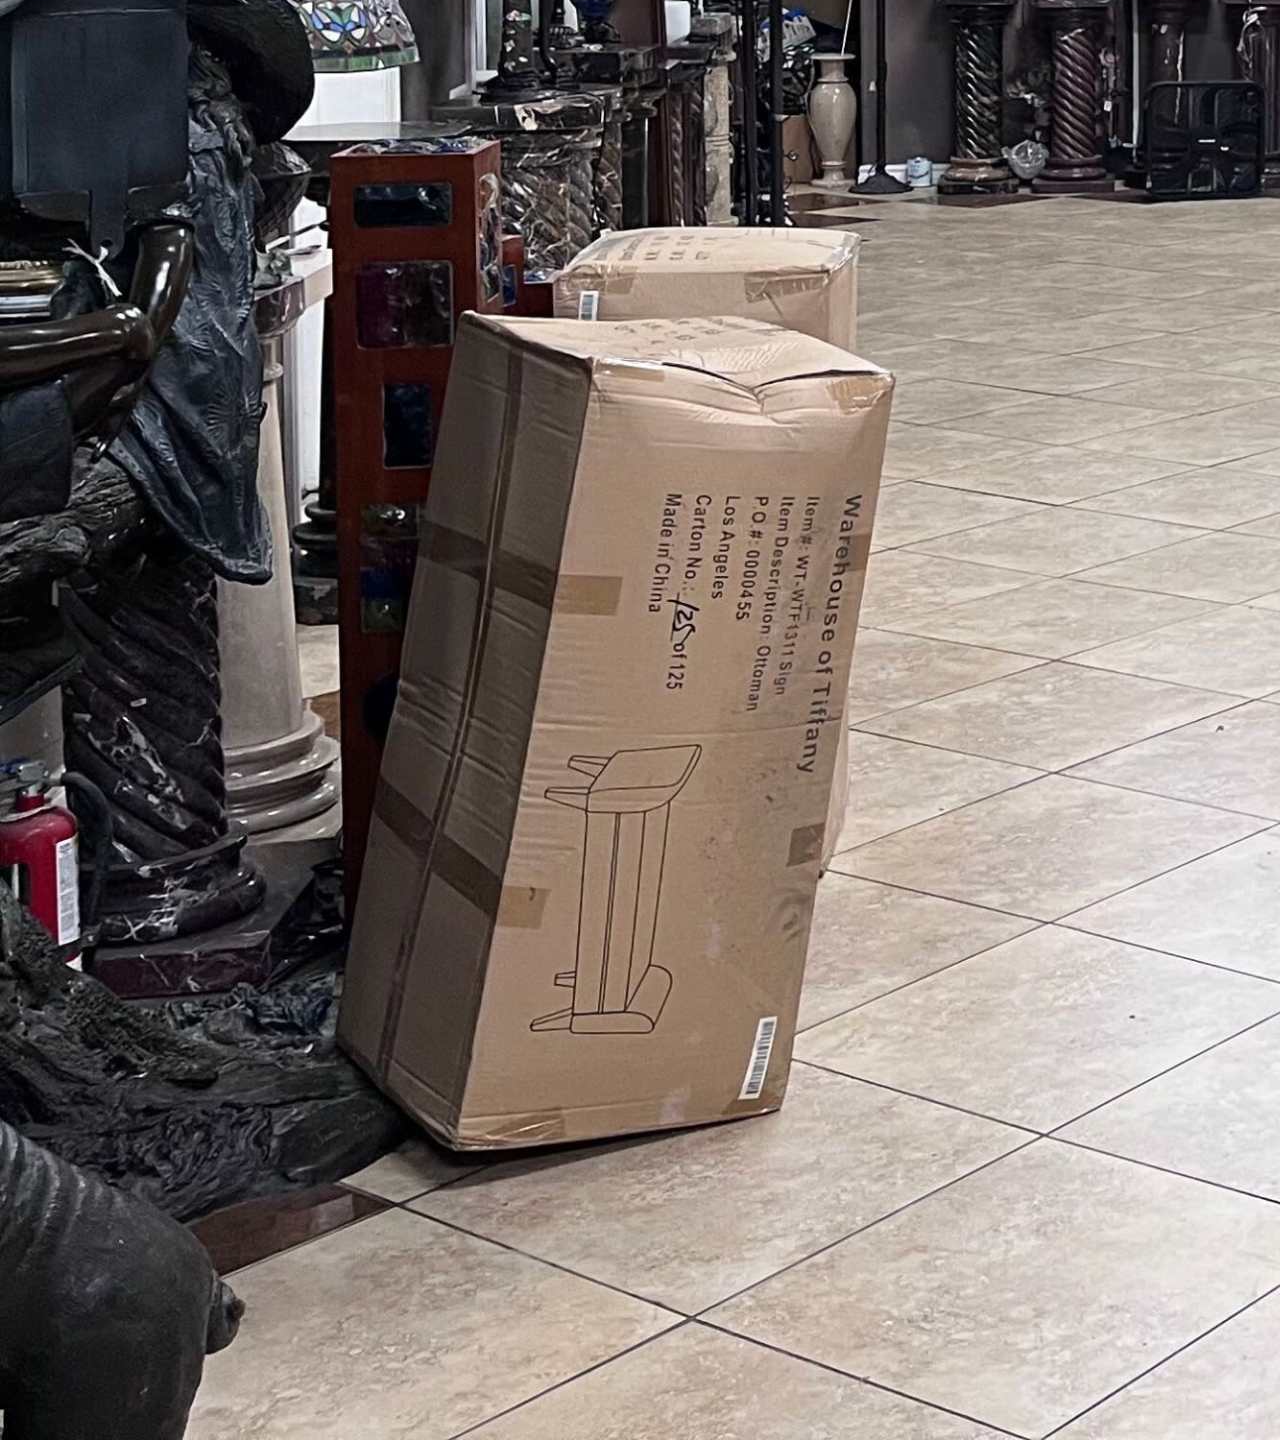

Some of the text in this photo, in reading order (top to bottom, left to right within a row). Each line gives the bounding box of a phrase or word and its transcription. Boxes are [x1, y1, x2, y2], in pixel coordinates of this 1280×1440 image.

[690, 494, 712, 553] Carton
[711, 496, 742, 600] Los Angeles
[803, 496, 821, 537] Item
[648, 494, 683, 613] Made in China
[735, 550, 760, 621] 0000455
[746, 496, 796, 711] Item Description: Ottoman
[796, 493, 863, 773] Warehouse of Tiffany
[666, 664, 685, 690] 125
[671, 643, 687, 660] of
[773, 661, 793, 696] Sign
